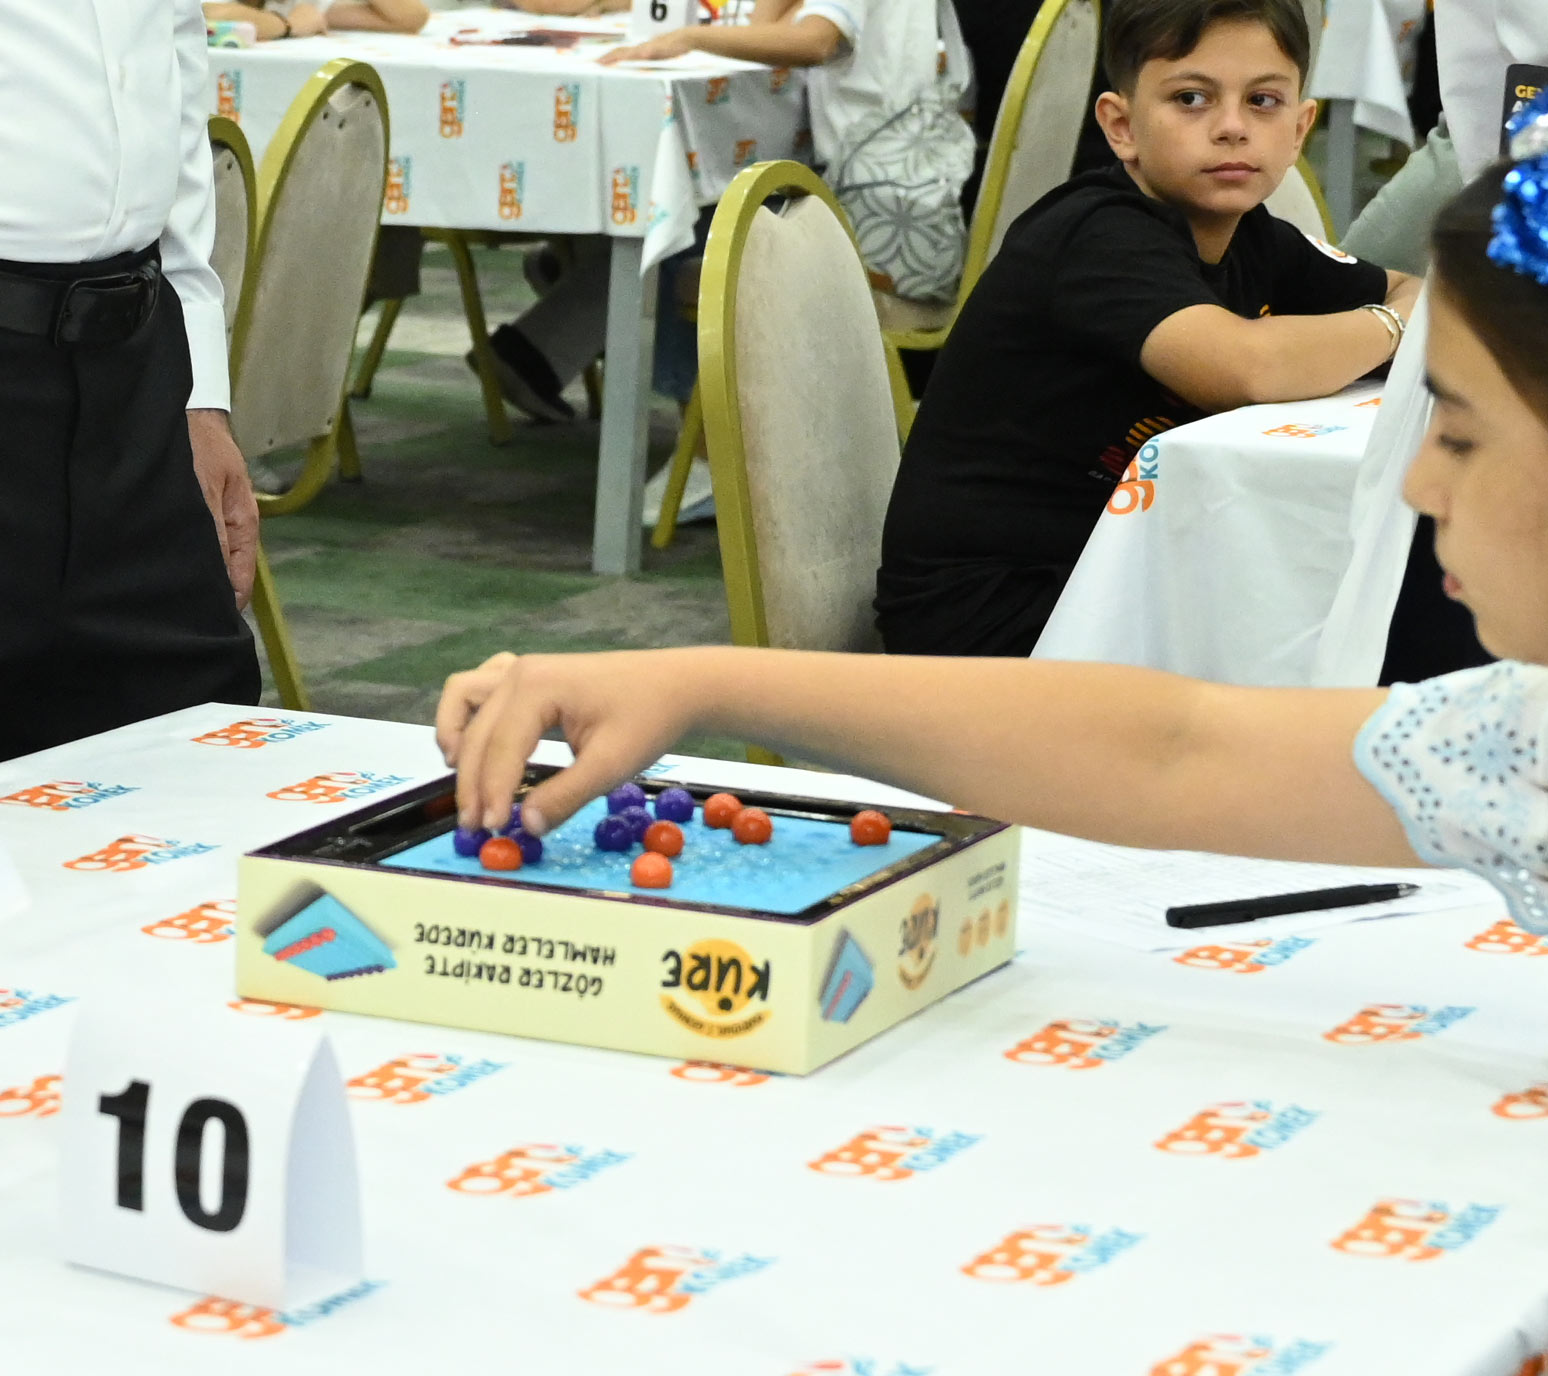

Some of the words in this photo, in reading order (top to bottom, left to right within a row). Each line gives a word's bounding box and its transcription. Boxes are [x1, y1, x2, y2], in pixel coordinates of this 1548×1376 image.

[503, 933, 616, 967] HAMLELER
[424, 954, 513, 987] RAKİPTE
[518, 967, 604, 999] GÖZLER
[661, 950, 772, 1013] KÜRE
[98, 1079, 250, 1233] 10
